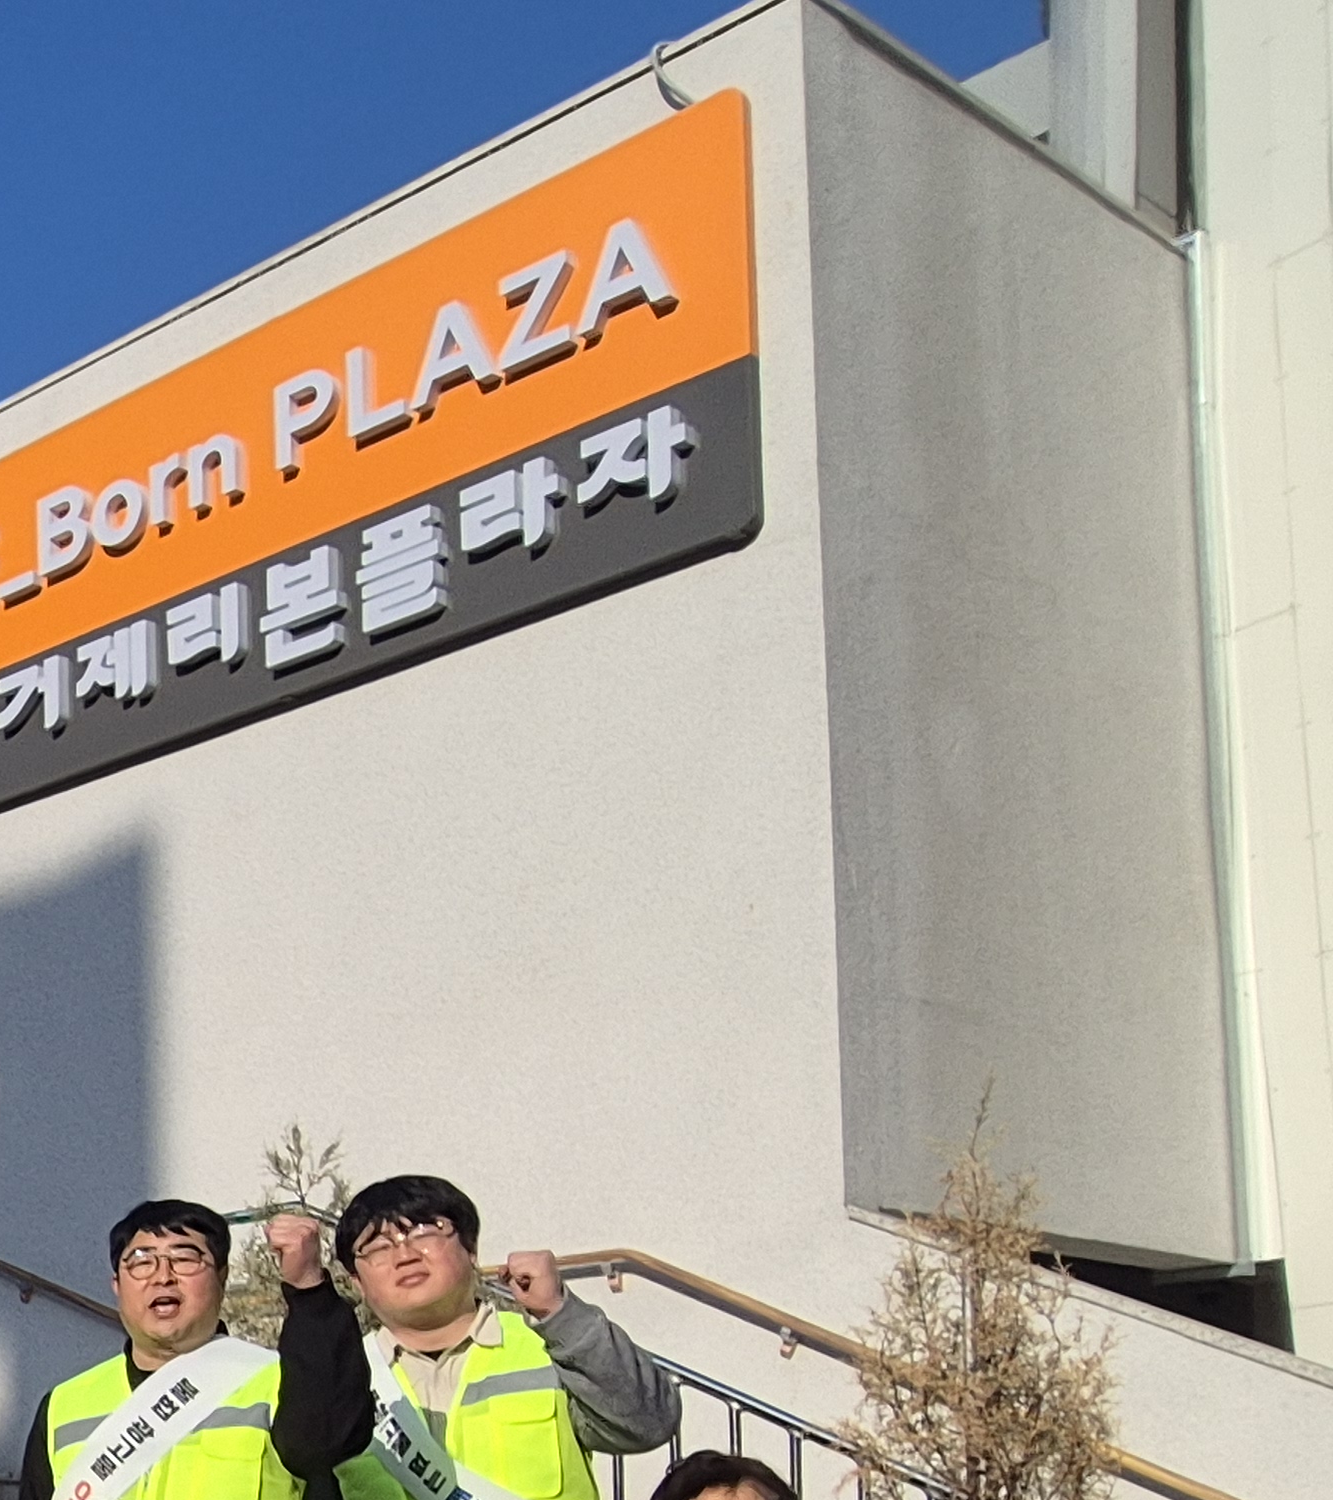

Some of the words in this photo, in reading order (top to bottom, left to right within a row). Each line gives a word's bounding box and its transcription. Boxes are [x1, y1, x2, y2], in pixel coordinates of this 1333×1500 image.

[273, 217, 678, 478] PLAZA
[150, 1377, 200, 1422] 불법
[90, 1415, 155, 1482] 광고물
